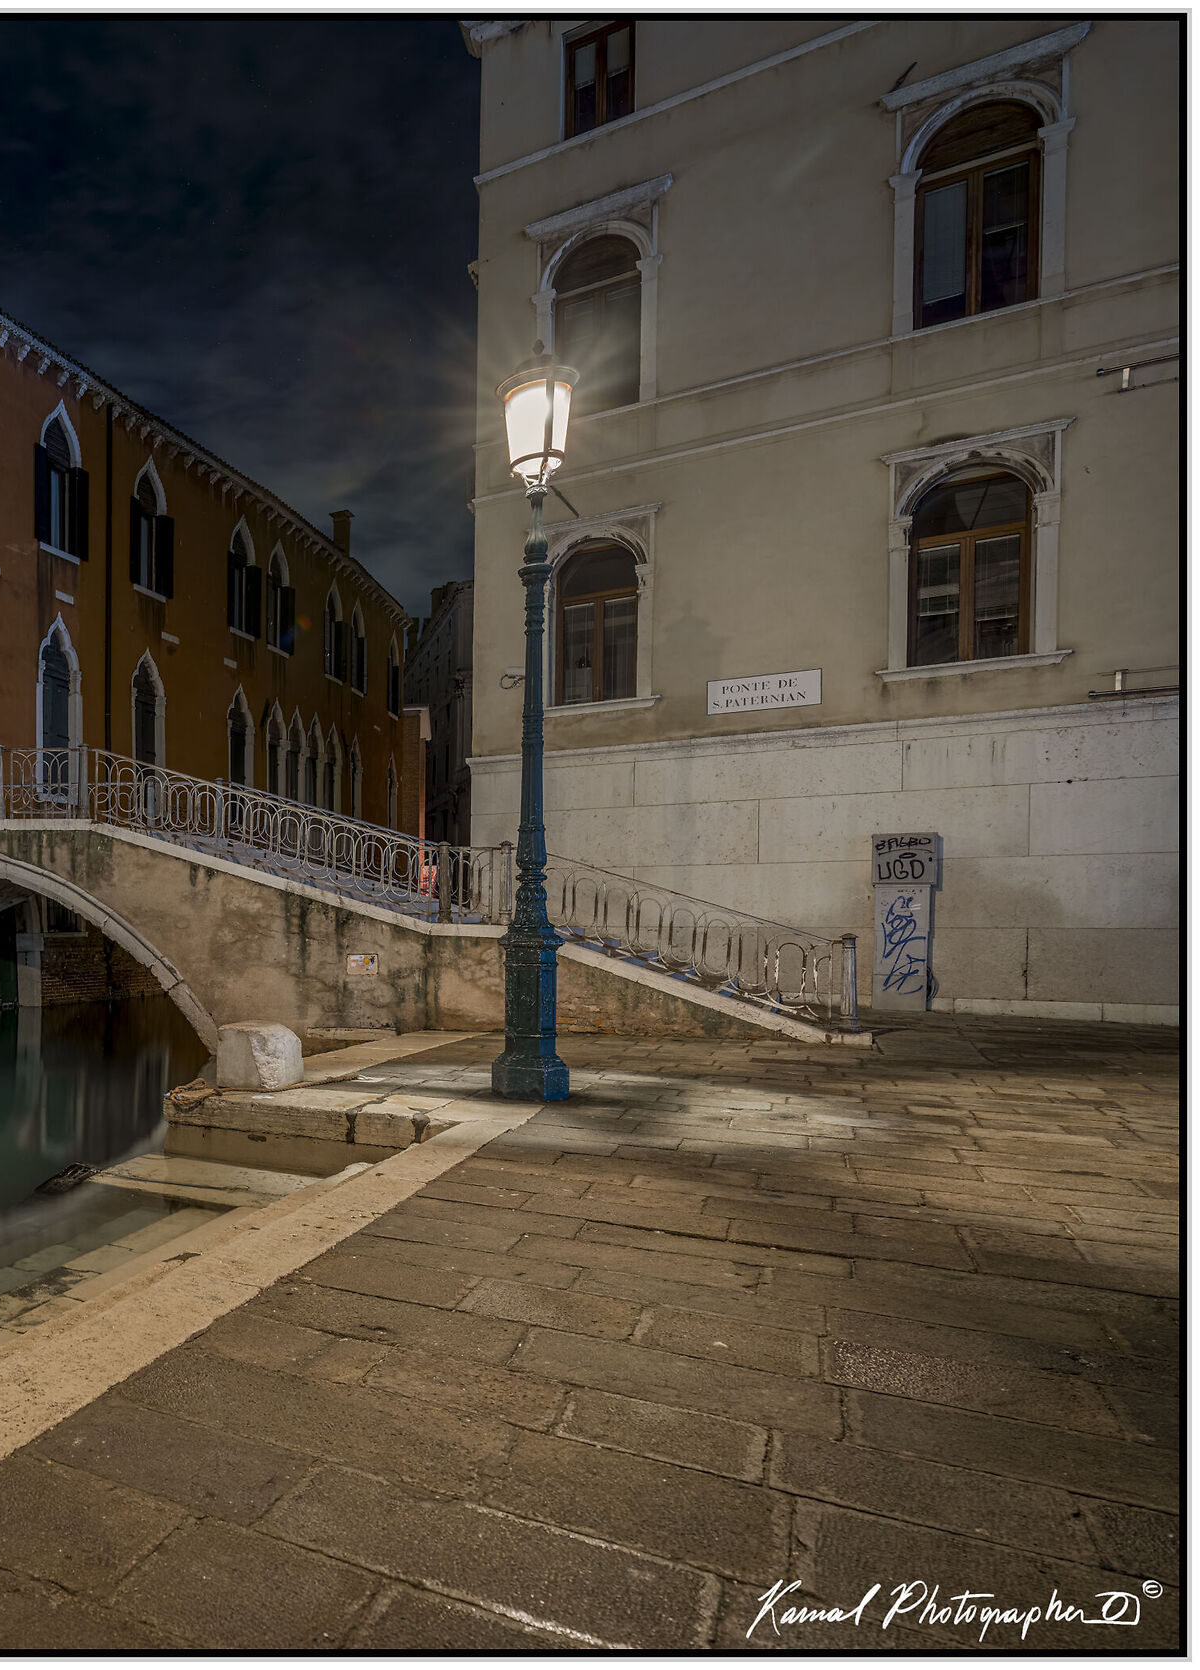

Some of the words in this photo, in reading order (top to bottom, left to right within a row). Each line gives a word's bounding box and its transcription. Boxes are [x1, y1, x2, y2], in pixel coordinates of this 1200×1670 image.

[722, 681, 770, 694] PONTE
[778, 678, 798, 688] DE
[878, 859, 925, 880] UGD
